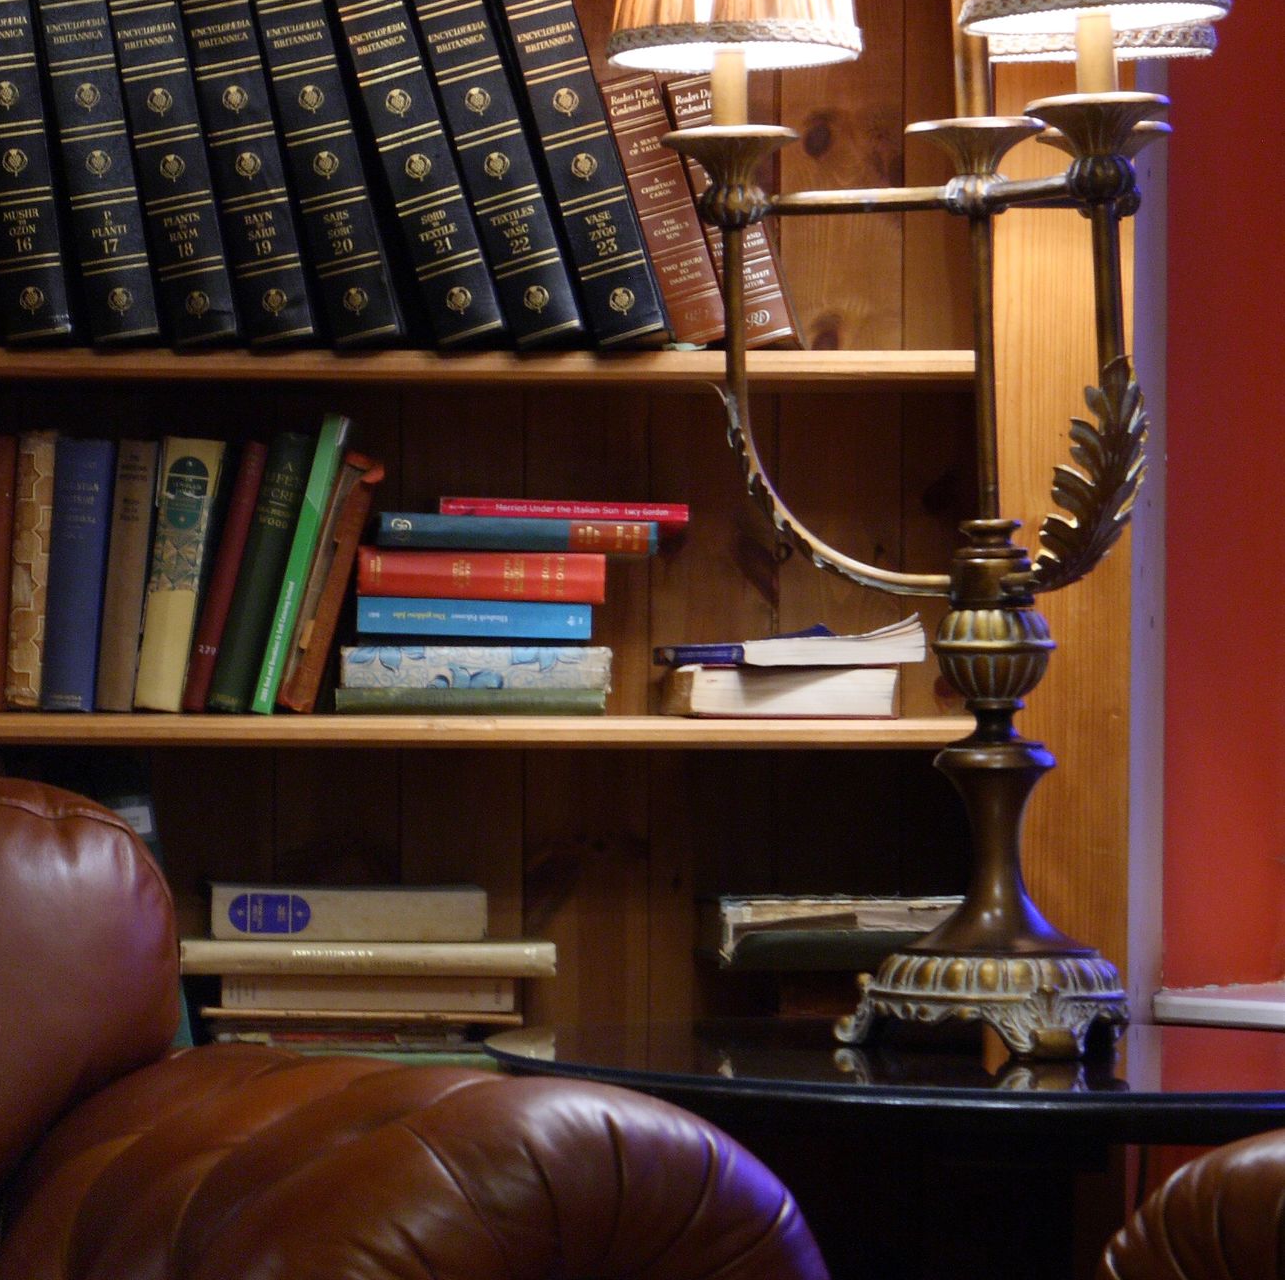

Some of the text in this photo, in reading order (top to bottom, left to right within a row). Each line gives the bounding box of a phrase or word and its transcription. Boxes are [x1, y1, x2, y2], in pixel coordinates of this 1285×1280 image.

[53, 30, 103, 45] BRITANNICA
[123, 34, 173, 50] BRITANNICA
[198, 32, 249, 49] BRITANNICA
[273, 32, 323, 48] BRITANNICA
[435, 34, 485, 54] BRITANNICA
[525, 34, 574, 54] BRITANNICA
[357, 36, 406, 56] BRITANNICA
[635, 87, 655, 100] Digest
[611, 96, 661, 117] Condensed Books
[675, 100, 707, 117] Condensed
[3, 208, 39, 222] MUSHR
[163, 212, 201, 228] PLANTS
[323, 210, 349, 224] SARS
[585, 211, 612, 226] VASE
[9, 224, 36, 237] OZON
[419, 222, 458, 242] TEXTILE
[503, 224, 529, 238] VASC
[588, 226, 617, 241] ZYGO
[15, 238, 33, 253] 16
[102, 238, 119, 254] 17
[177, 242, 194, 258] 18
[255, 240, 273, 256] 19
[332, 240, 354, 256] 20
[433, 236, 453, 254] 21
[510, 236, 531, 254] 22
[596, 239, 618, 256] 23
[495, 503, 669, 518] Married Under the Italian Sun Lucy Gordon
